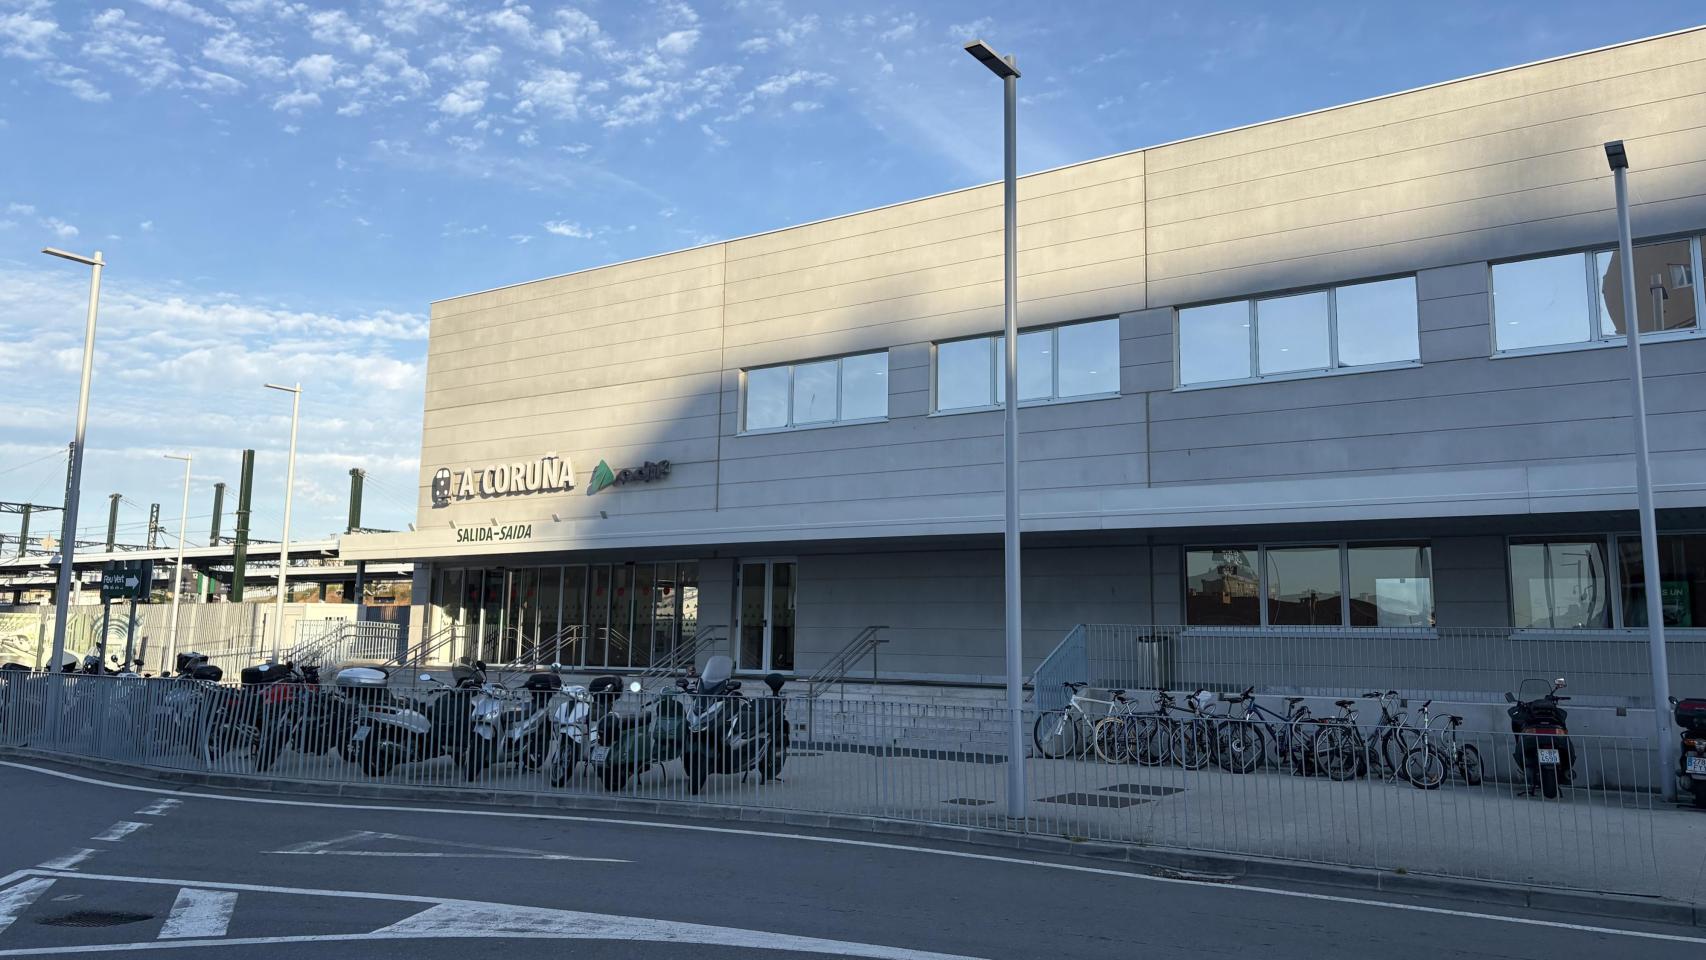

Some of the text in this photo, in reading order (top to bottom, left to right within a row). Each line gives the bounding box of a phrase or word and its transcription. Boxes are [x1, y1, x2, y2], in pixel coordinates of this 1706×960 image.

[460, 452, 575, 497] A CORUÑA
[457, 524, 532, 542] SALIDA-SAIDA
